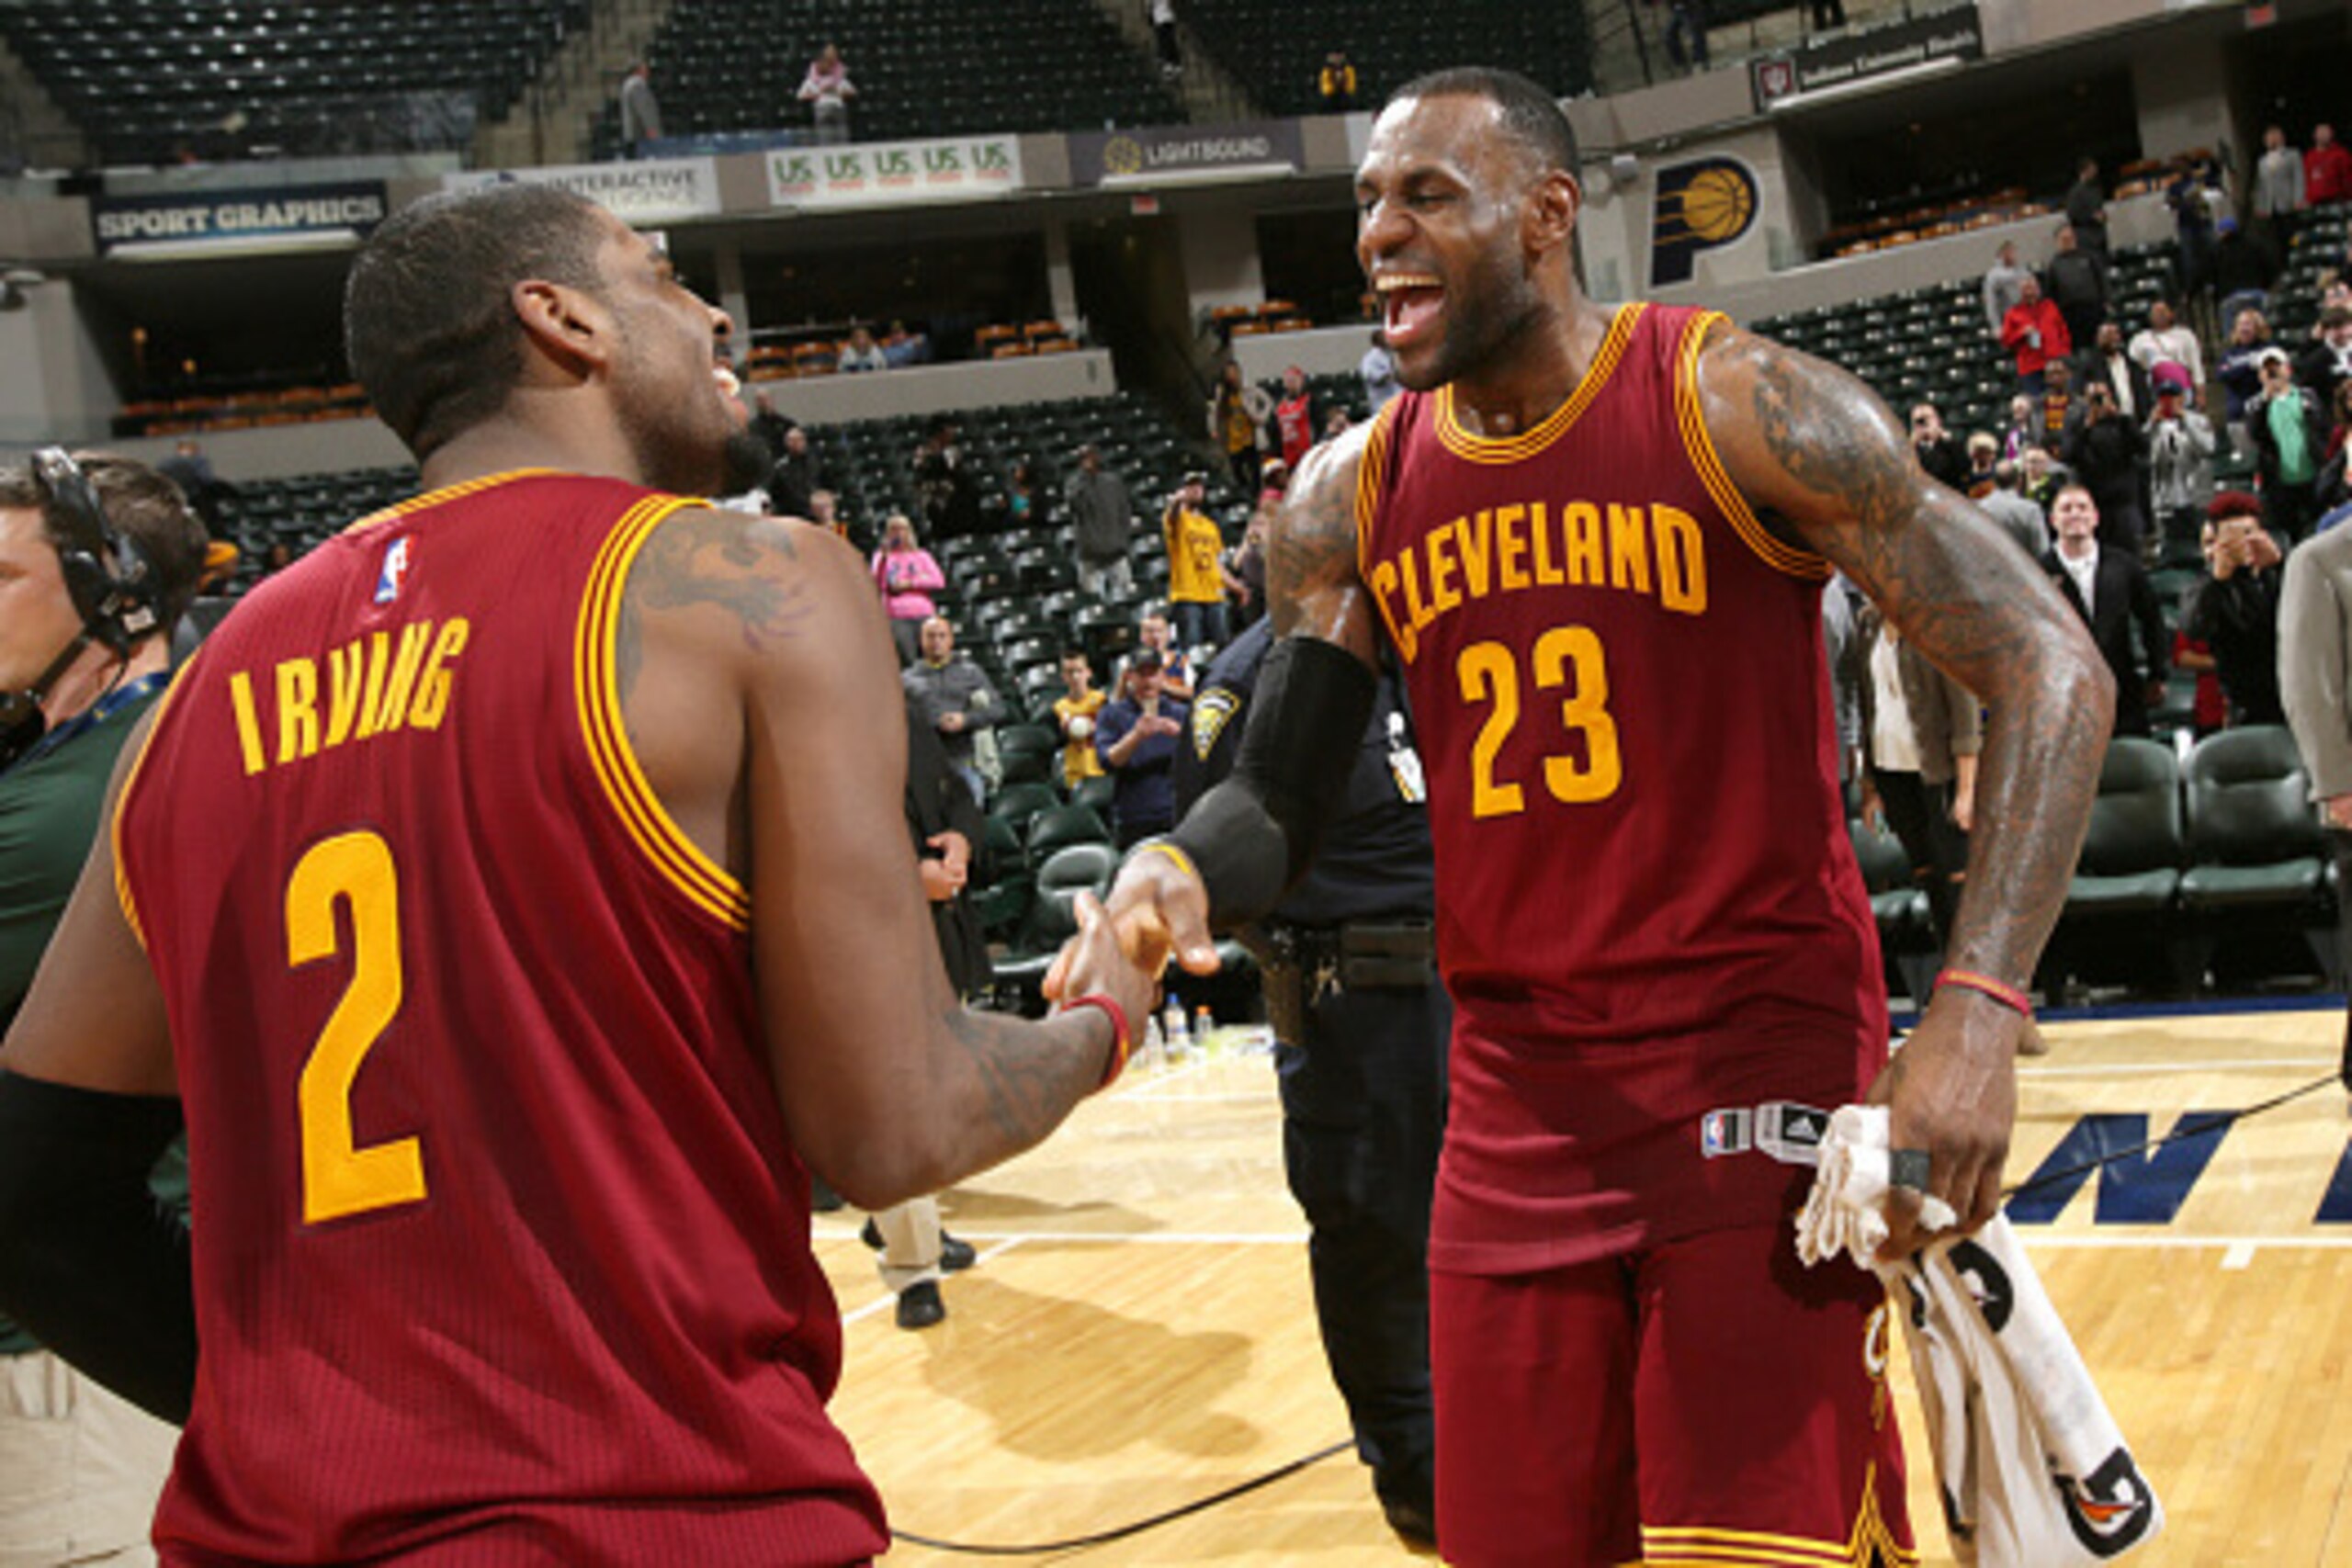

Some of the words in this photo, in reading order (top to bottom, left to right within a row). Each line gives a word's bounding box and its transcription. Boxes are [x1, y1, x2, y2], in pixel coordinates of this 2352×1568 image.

[97, 206, 209, 239] SPORT
[216, 195, 381, 228] GRAPHICS
[1373, 500, 1707, 665] CLEVELAND
[230, 616, 470, 775] IRVING
[1456, 625, 1623, 819] 23
[284, 830, 427, 1224] 2
